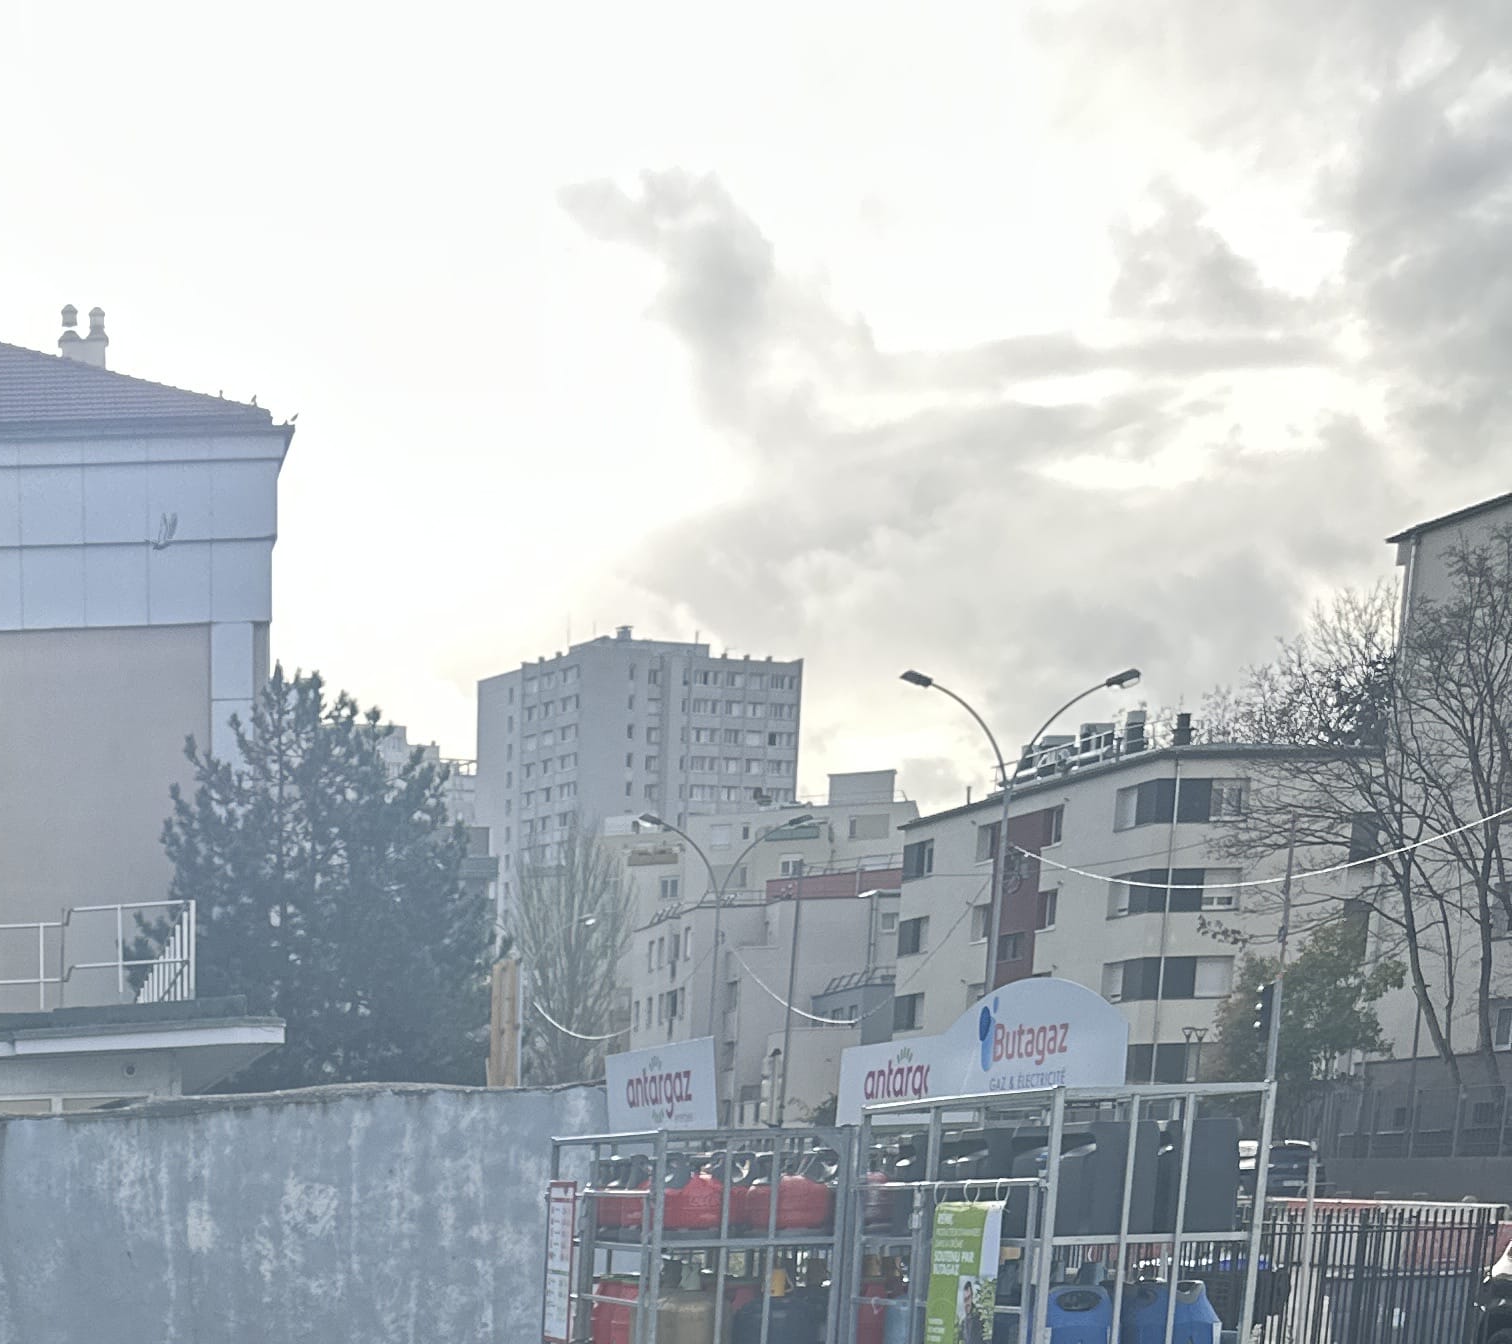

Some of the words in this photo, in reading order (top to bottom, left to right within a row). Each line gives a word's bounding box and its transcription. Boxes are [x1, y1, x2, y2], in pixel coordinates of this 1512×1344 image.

[992, 1022, 1069, 1065] Butagaz
[626, 1067, 693, 1119] antargaz
[989, 1075, 1006, 1091] GAZ
[1008, 1075, 1015, 1090] &
